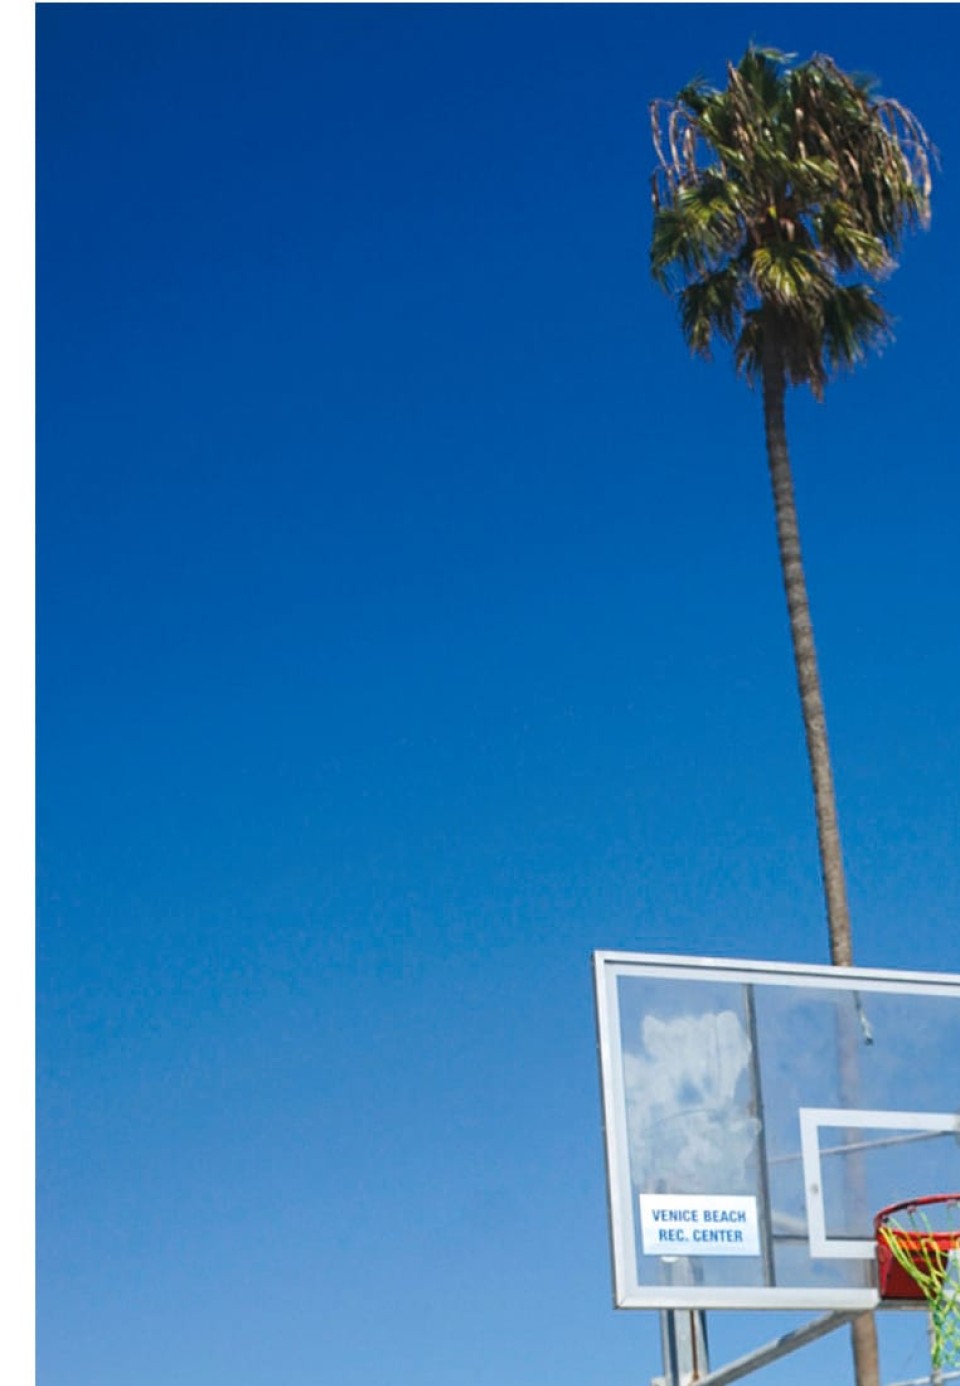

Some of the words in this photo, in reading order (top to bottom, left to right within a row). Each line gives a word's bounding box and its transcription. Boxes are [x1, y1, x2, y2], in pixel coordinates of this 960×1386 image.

[652, 1209, 699, 1222] VENICE
[703, 1210, 746, 1223] BEACH
[659, 1229, 689, 1242] REC.
[693, 1229, 743, 1243] CENTER
